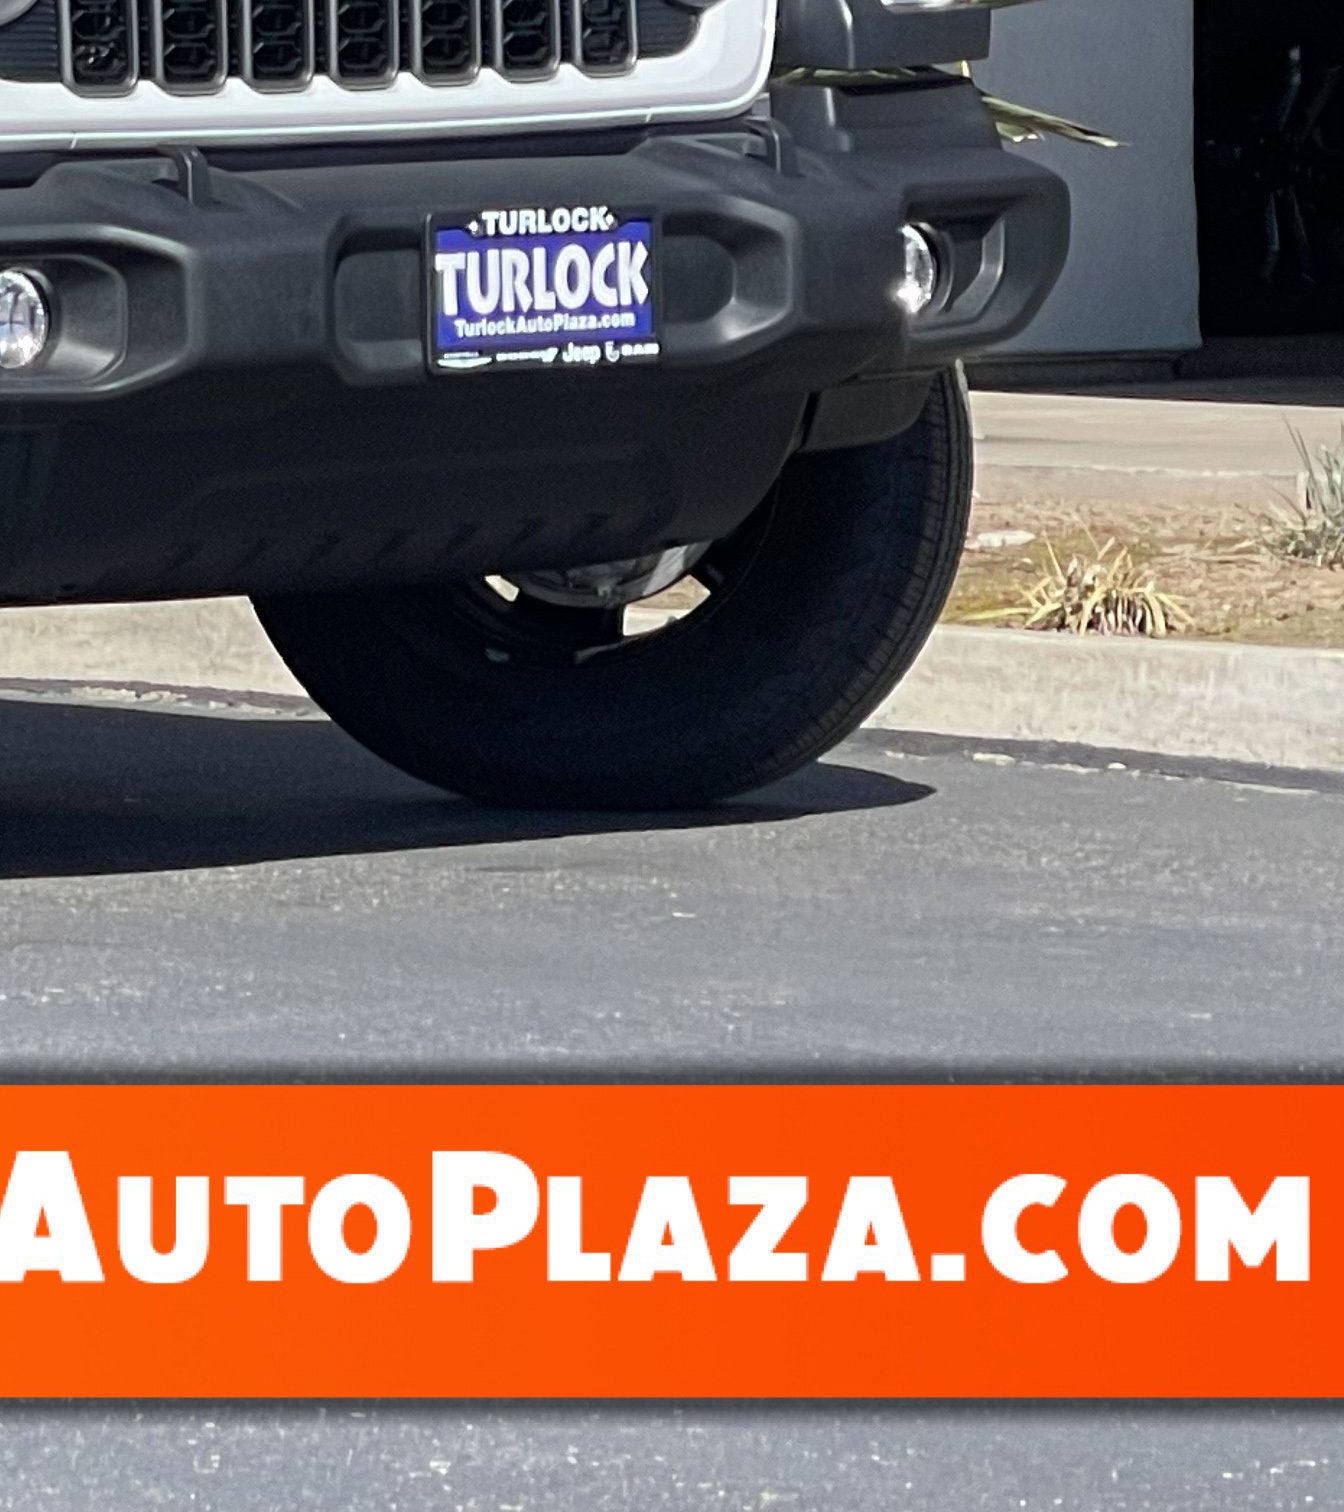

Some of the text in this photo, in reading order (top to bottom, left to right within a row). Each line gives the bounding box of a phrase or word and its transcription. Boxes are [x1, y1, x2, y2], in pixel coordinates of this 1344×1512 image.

[481, 206, 609, 236] TURLOCK
[435, 240, 649, 316] TURLOCK
[454, 312, 636, 338] TurlockAutoPlaza.com
